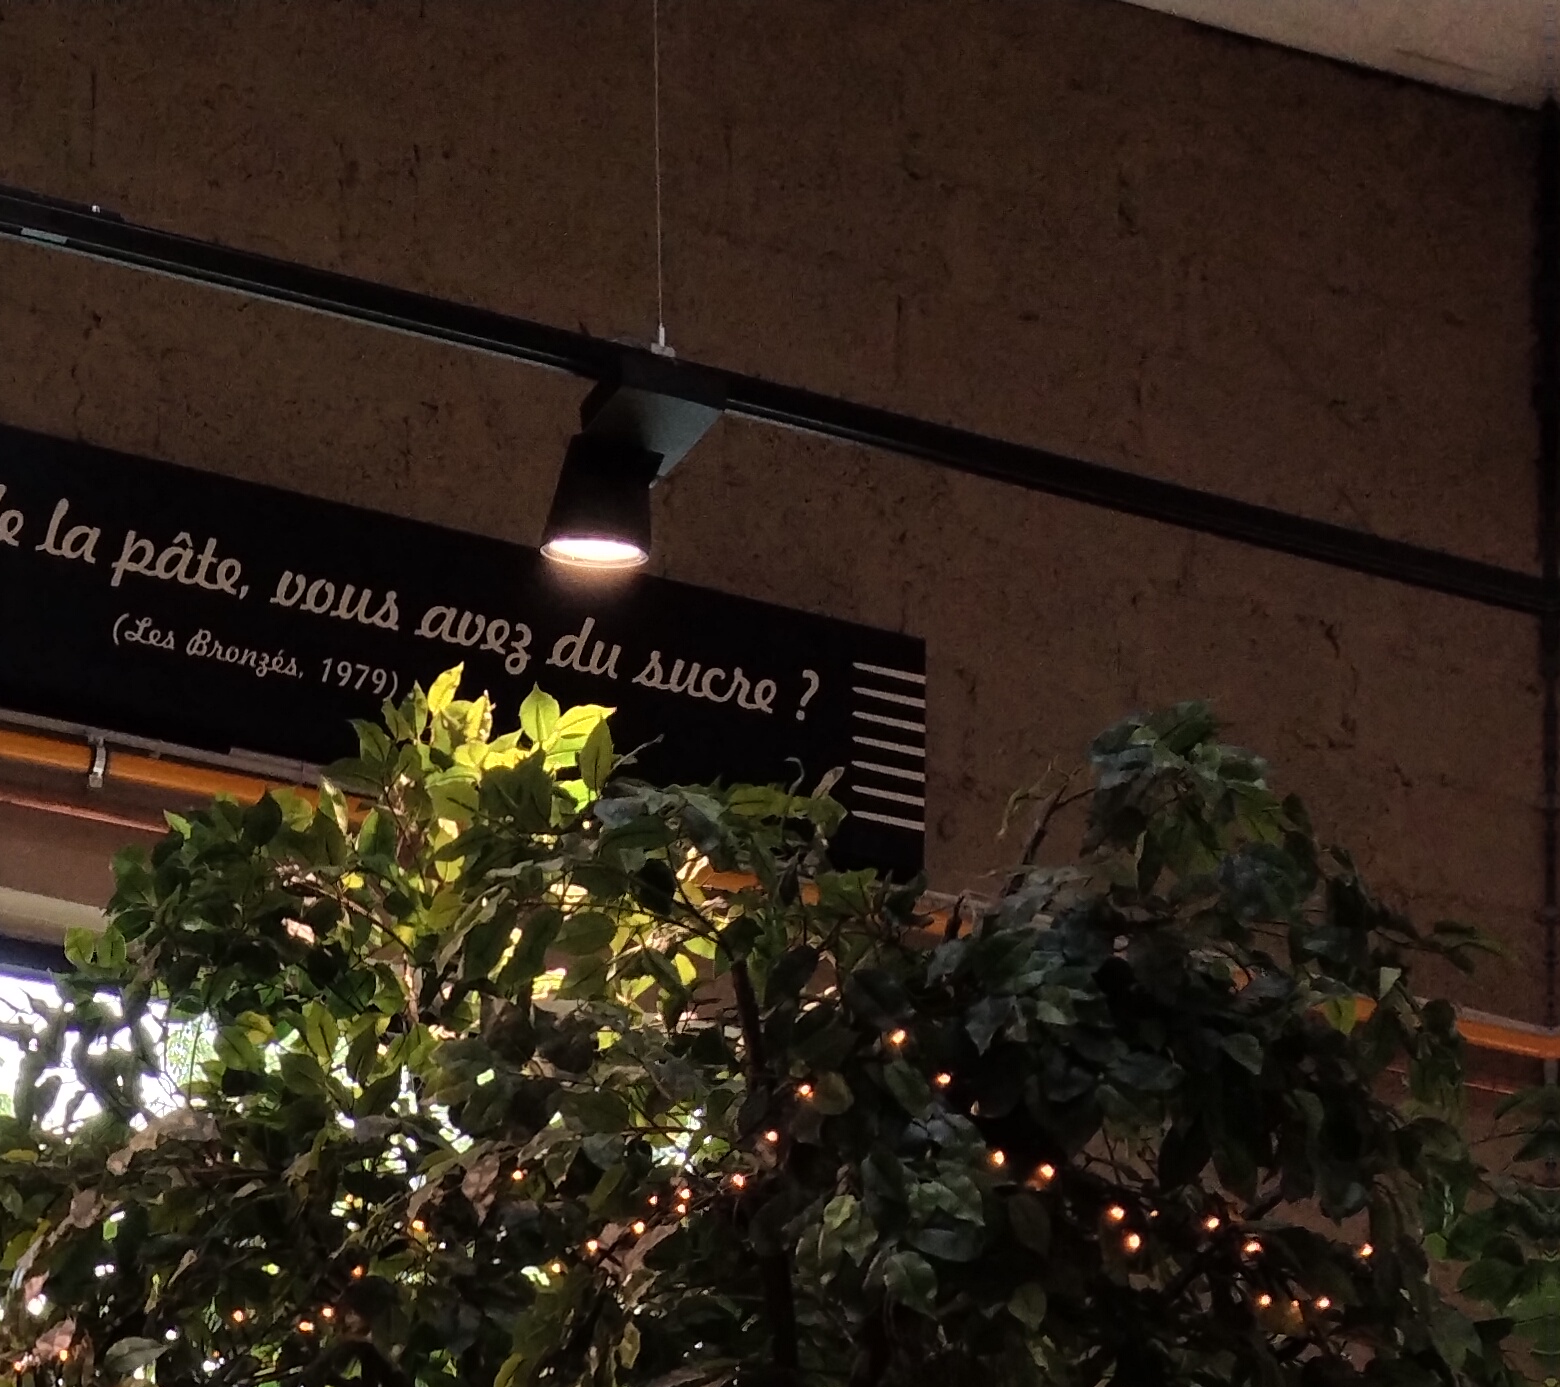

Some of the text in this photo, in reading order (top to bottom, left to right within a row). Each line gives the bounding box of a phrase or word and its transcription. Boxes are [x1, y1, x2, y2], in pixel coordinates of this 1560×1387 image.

[34, 497, 100, 565] la
[111, 530, 250, 600] pâte,
[269, 568, 400, 632] vous
[414, 603, 533, 676] avez
[545, 616, 624, 679] du
[632, 648, 779, 715] sucre
[794, 668, 821, 722] ?
[112, 612, 400, 700] (Les Bronzés, 1979)
